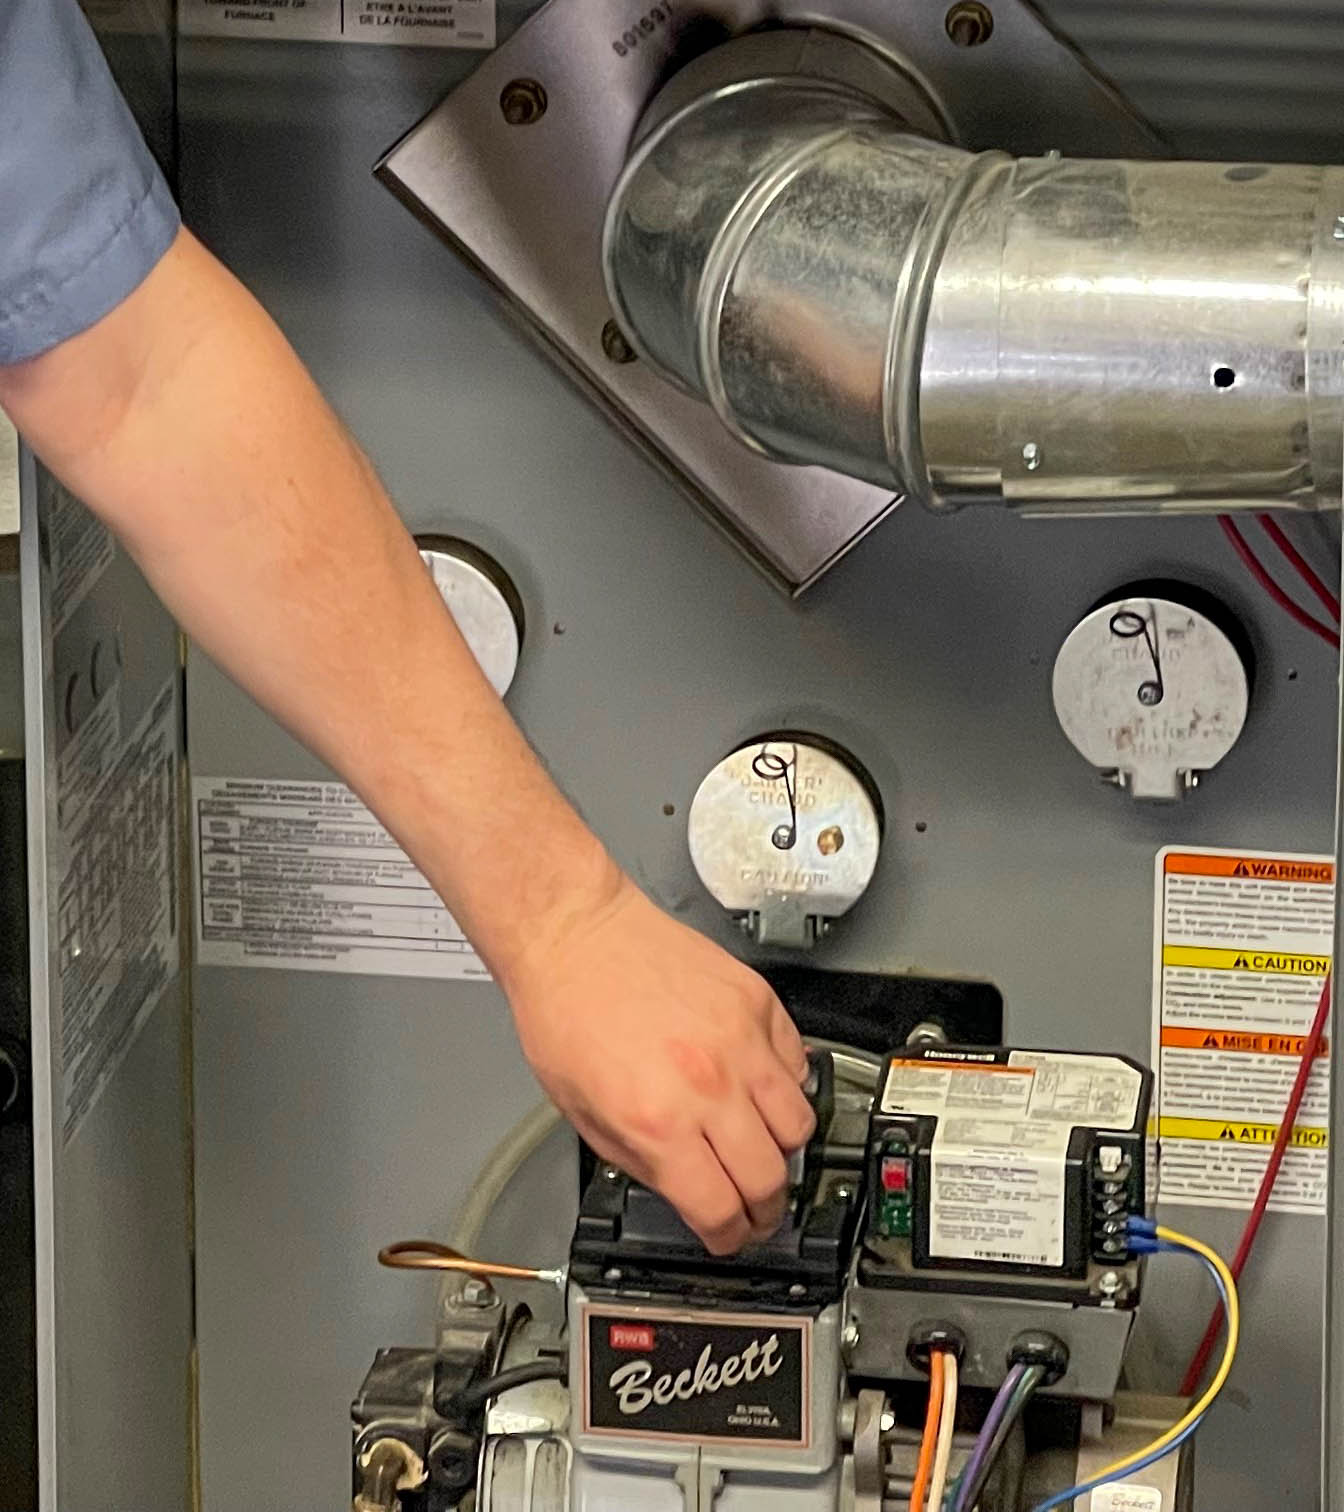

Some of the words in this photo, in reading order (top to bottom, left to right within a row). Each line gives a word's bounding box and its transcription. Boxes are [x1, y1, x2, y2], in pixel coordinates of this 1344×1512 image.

[1251, 863, 1332, 881] WARNING
[1253, 955, 1327, 972] CAUTION
[609, 1333, 783, 1415] Beckett
